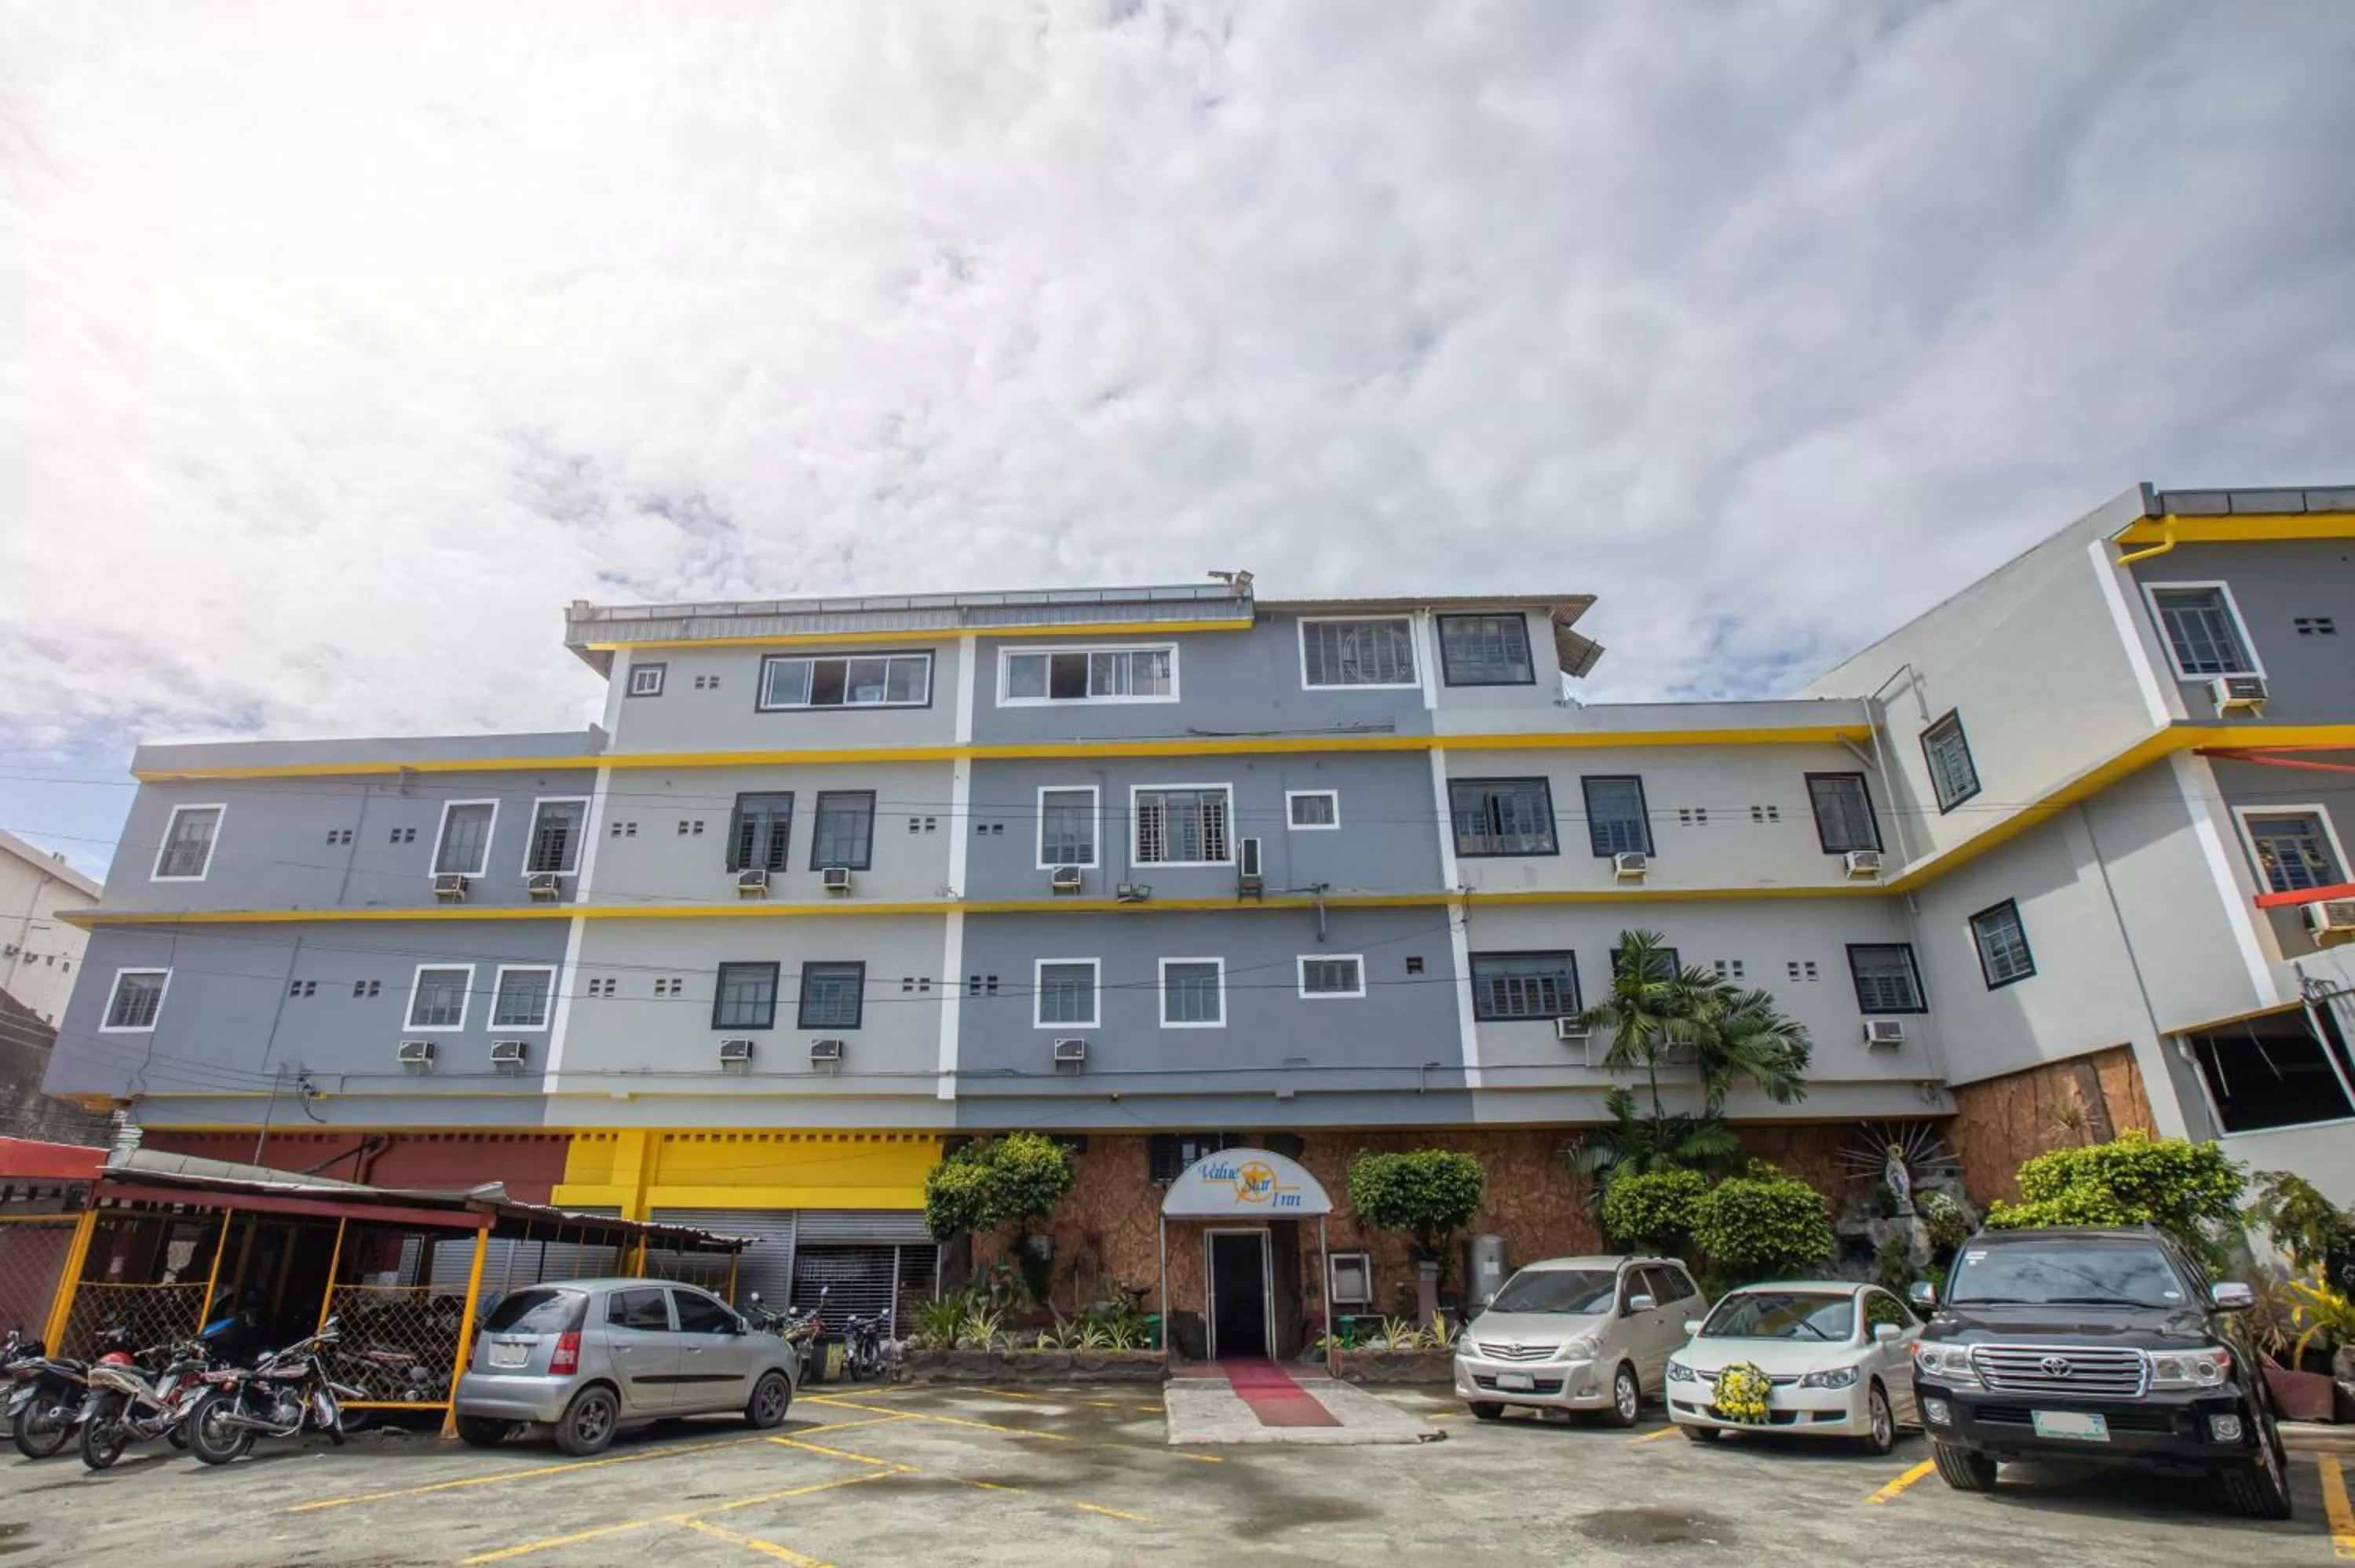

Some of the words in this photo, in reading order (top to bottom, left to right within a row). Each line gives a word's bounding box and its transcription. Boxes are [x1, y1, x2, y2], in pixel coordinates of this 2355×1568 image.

[1198, 1161, 1241, 1180] Value
[1241, 1176, 1272, 1193] Star
[1271, 1191, 1302, 1207] Inn
